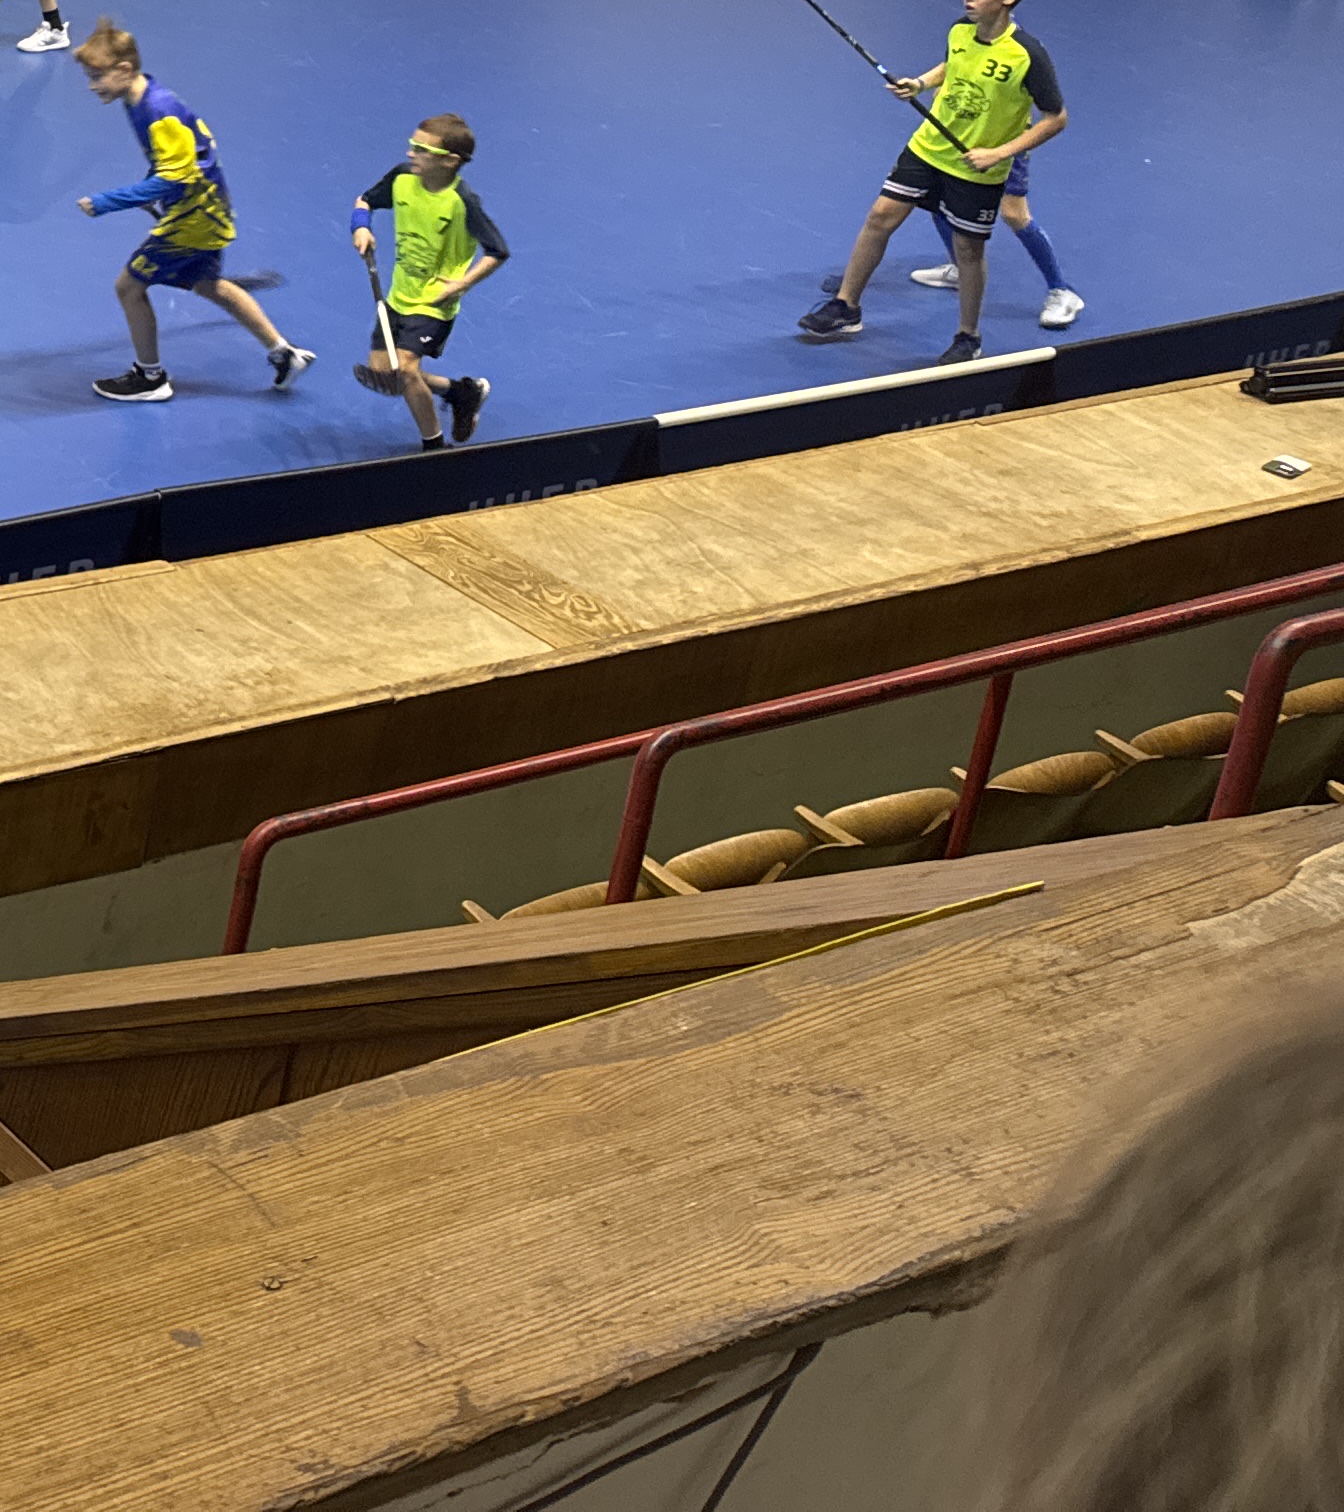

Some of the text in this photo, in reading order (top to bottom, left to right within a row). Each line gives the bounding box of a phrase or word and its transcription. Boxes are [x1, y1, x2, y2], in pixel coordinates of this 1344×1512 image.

[981, 58, 1013, 82] 33
[977, 209, 995, 222] 33
[438, 216, 452, 235] 7
